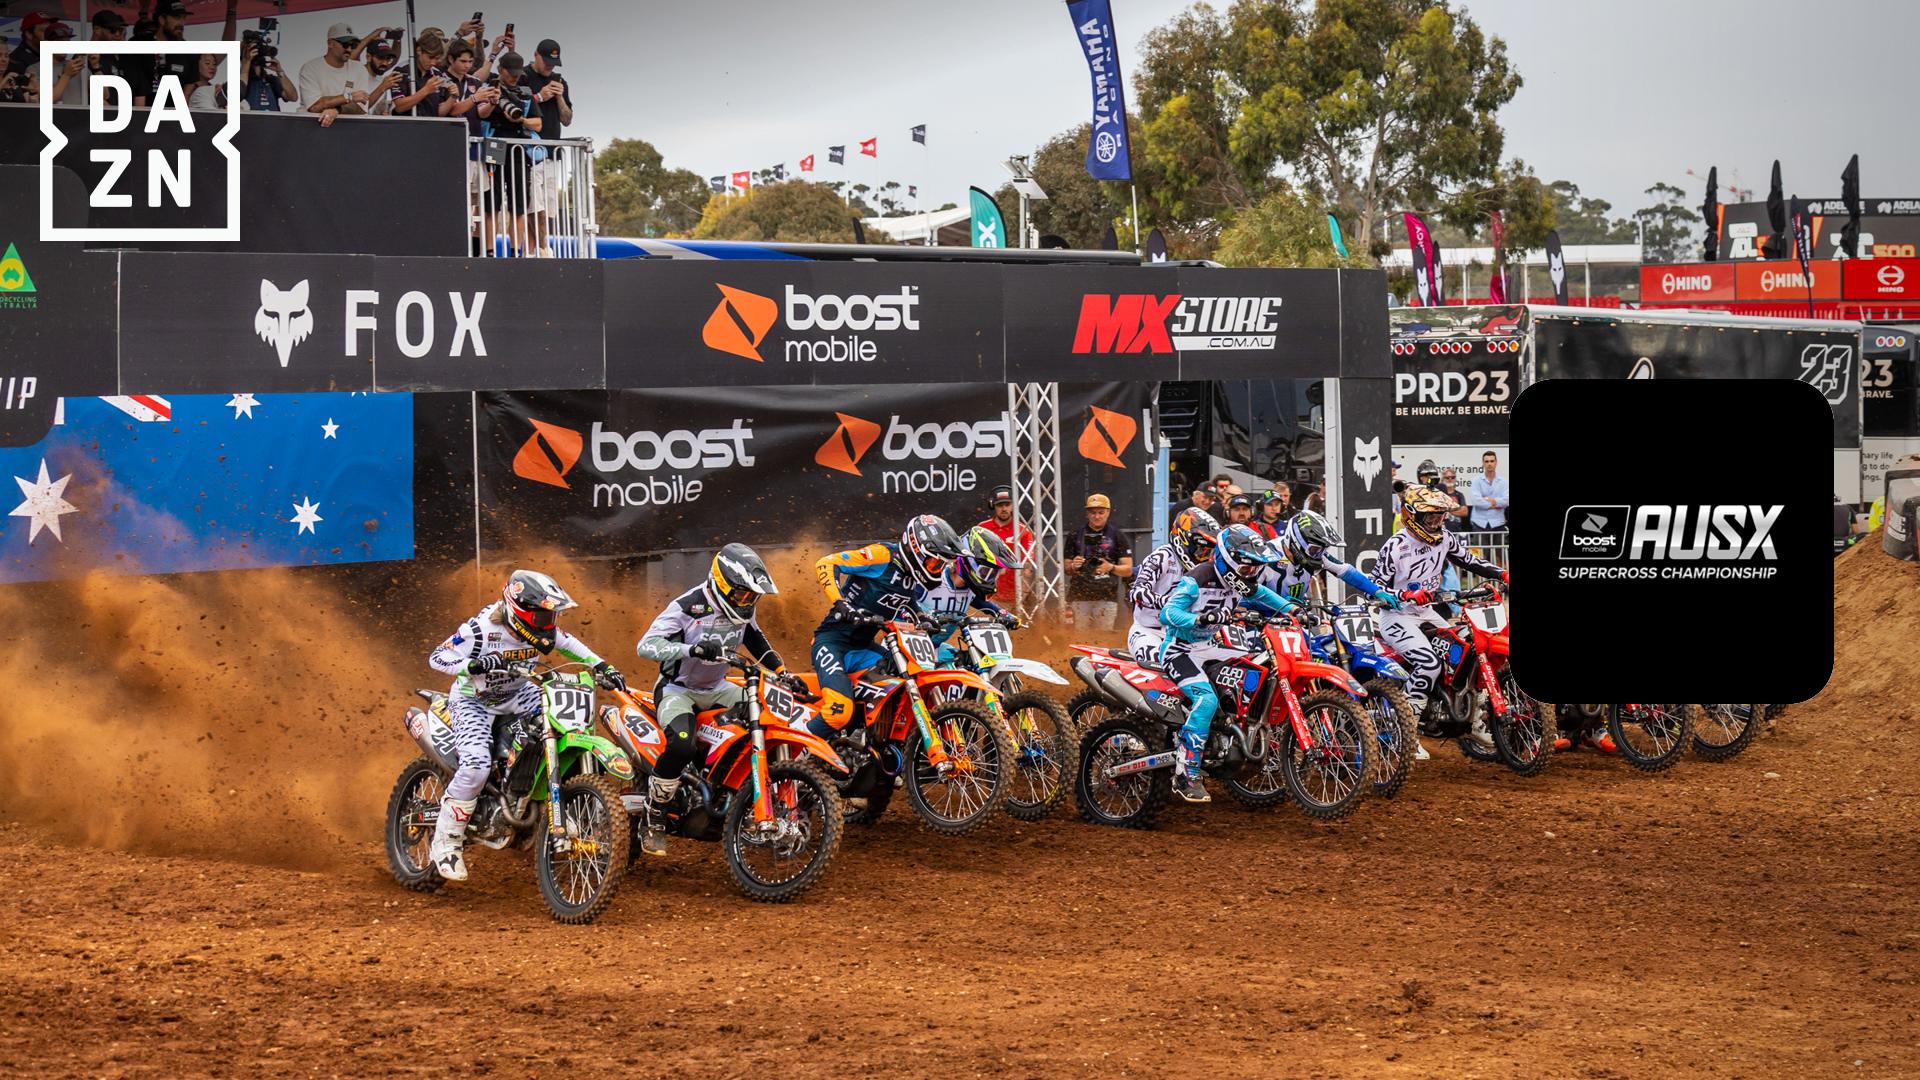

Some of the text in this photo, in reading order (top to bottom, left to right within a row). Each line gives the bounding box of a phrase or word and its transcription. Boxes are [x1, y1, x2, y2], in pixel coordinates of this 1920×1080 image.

[1080, 17, 1110, 131] YAMAHA
[1102, 24, 1122, 148] RACING
[1824, 201, 1865, 210] ADELE
[1873, 244, 1915, 258] 500
[1676, 275, 1712, 291] HINO
[1776, 273, 1815, 288] HINO
[785, 284, 920, 331] boost
[345, 289, 488, 358] FOX
[785, 335, 878, 362] mobile
[1206, 337, 1273, 348] .COM.AU
[1799, 344, 1852, 405] 23
[0, 377, 37, 409] IP
[1395, 371, 1511, 403] PRD23
[1395, 405, 1511, 416] BE HUNGRY. BE BRAVE.
[592, 418, 756, 473] boost
[1881, 452, 1893, 460] life
[882, 464, 977, 494] mobile
[1467, 465, 1484, 474] and
[593, 475, 703, 508] mobile
[816, 564, 832, 588] FOX
[1343, 618, 1374, 642] 14
[1482, 609, 1498, 629] 1
[514, 621, 541, 645] PENRITE
[980, 630, 1008, 654] 11
[1279, 631, 1302, 653] 17
[1385, 622, 1414, 643] FLY
[815, 645, 845, 676] FOX
[905, 637, 935, 662] 199
[1219, 665, 1245, 679] QUAD
[554, 690, 592, 723] 24
[766, 687, 793, 717] 45
[625, 714, 656, 738] 45
